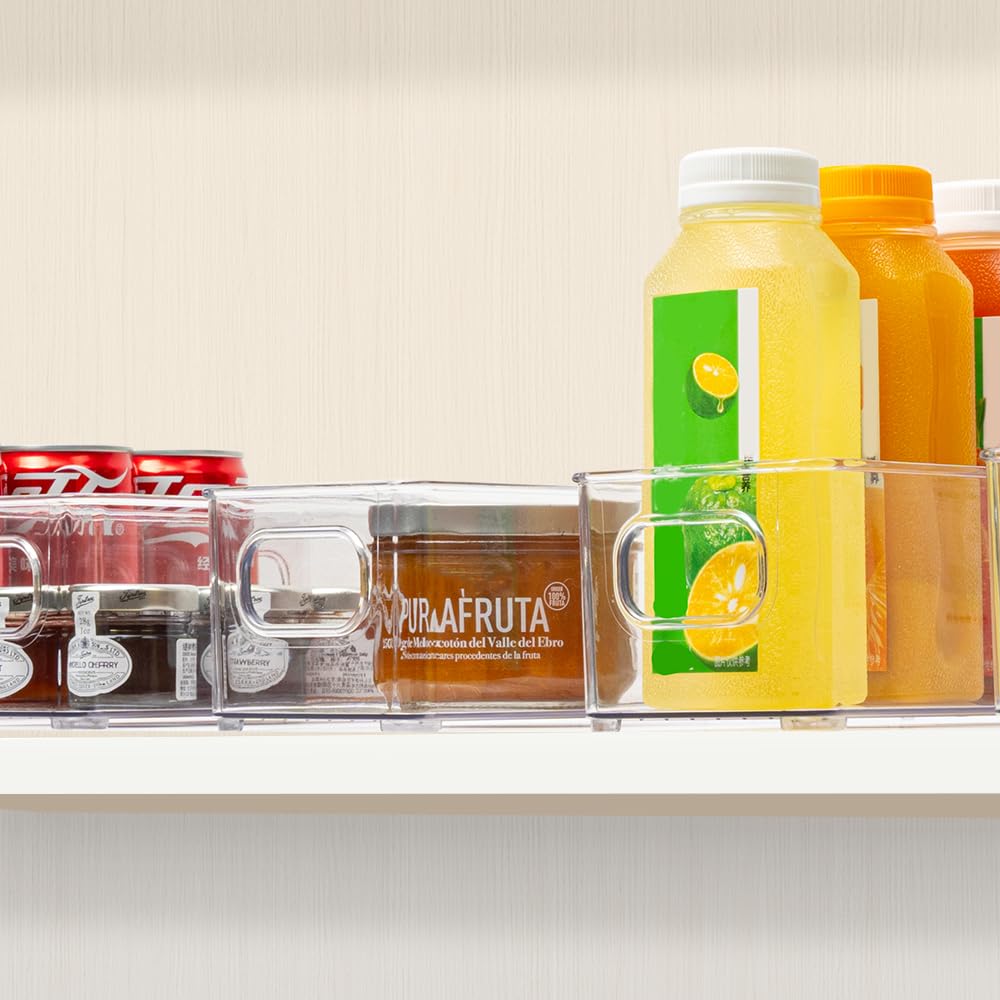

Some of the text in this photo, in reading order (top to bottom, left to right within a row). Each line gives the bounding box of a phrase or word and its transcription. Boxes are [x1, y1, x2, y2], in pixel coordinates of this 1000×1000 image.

[469, 637, 486, 649] del
[487, 637, 517, 649] Valle
[518, 637, 535, 649] del
[537, 636, 565, 649] Ebro
[503, 650, 513, 660] de
[522, 650, 541, 660] fruta
